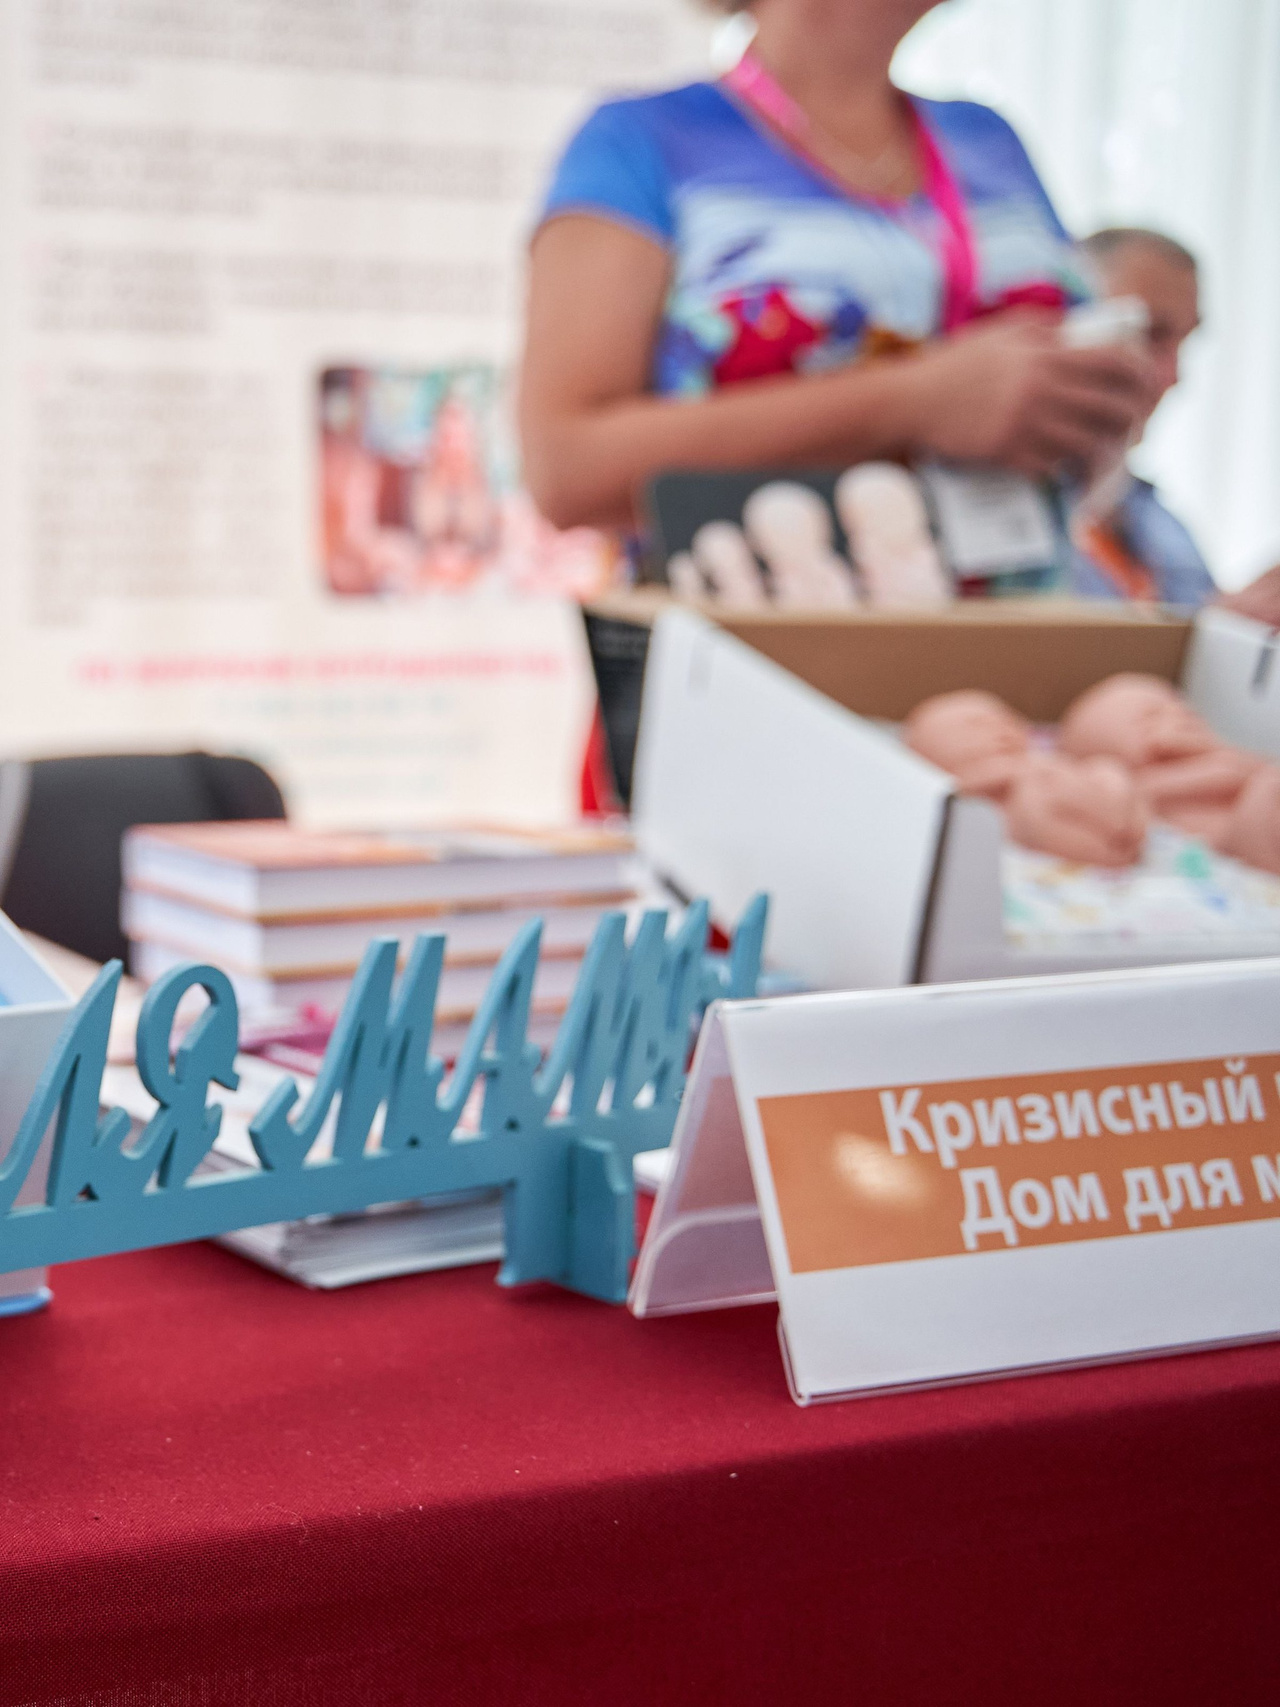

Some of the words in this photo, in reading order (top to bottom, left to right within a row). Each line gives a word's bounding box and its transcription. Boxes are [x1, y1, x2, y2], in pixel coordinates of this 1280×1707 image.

[880, 1060, 1265, 1169] Кризисный
[960, 1168, 1109, 1250] Дом
[1123, 1158, 1244, 1231] для
